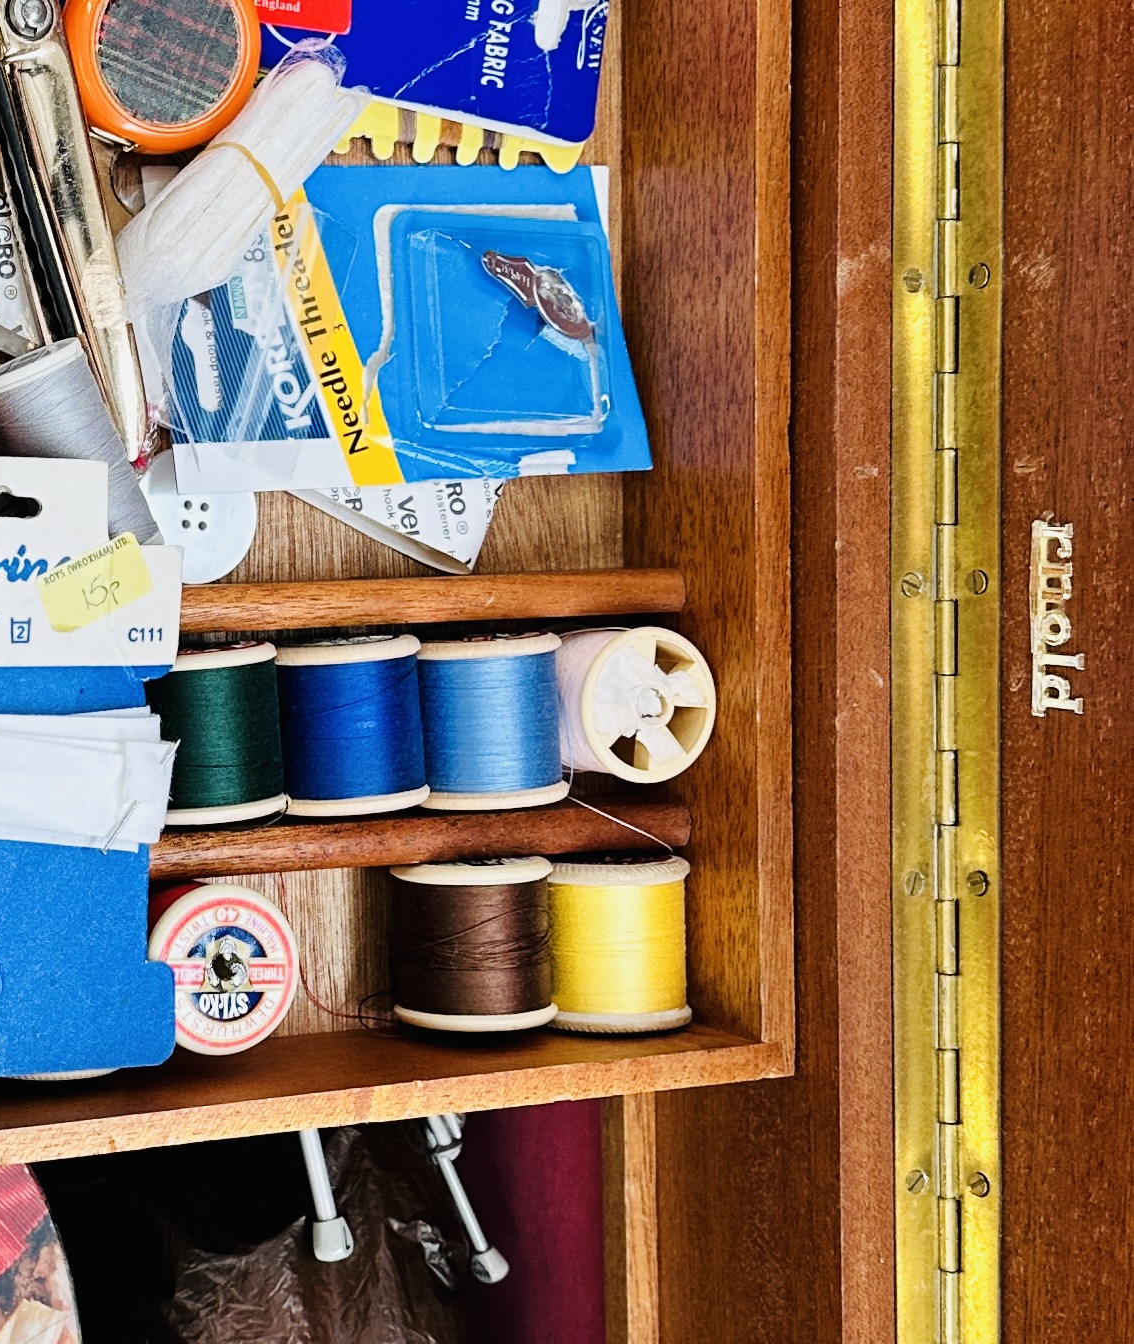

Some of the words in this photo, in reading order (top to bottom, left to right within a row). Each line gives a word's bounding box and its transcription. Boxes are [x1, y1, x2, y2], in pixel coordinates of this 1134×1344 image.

[480, 18, 514, 91] FABRIC
[587, 23, 605, 71] SEW
[333, 324, 347, 333] 3
[319, 351, 369, 456] Needle
[382, 489, 396, 519] hook
[435, 489, 452, 541] fastener
[43, 568, 66, 586] ROYS
[127, 627, 164, 643] C111
[216, 908, 238, 921] 40
[174, 915, 210, 952] TWIST
[243, 913, 280, 954] MACHINE
[250, 966, 284, 980] THREE
